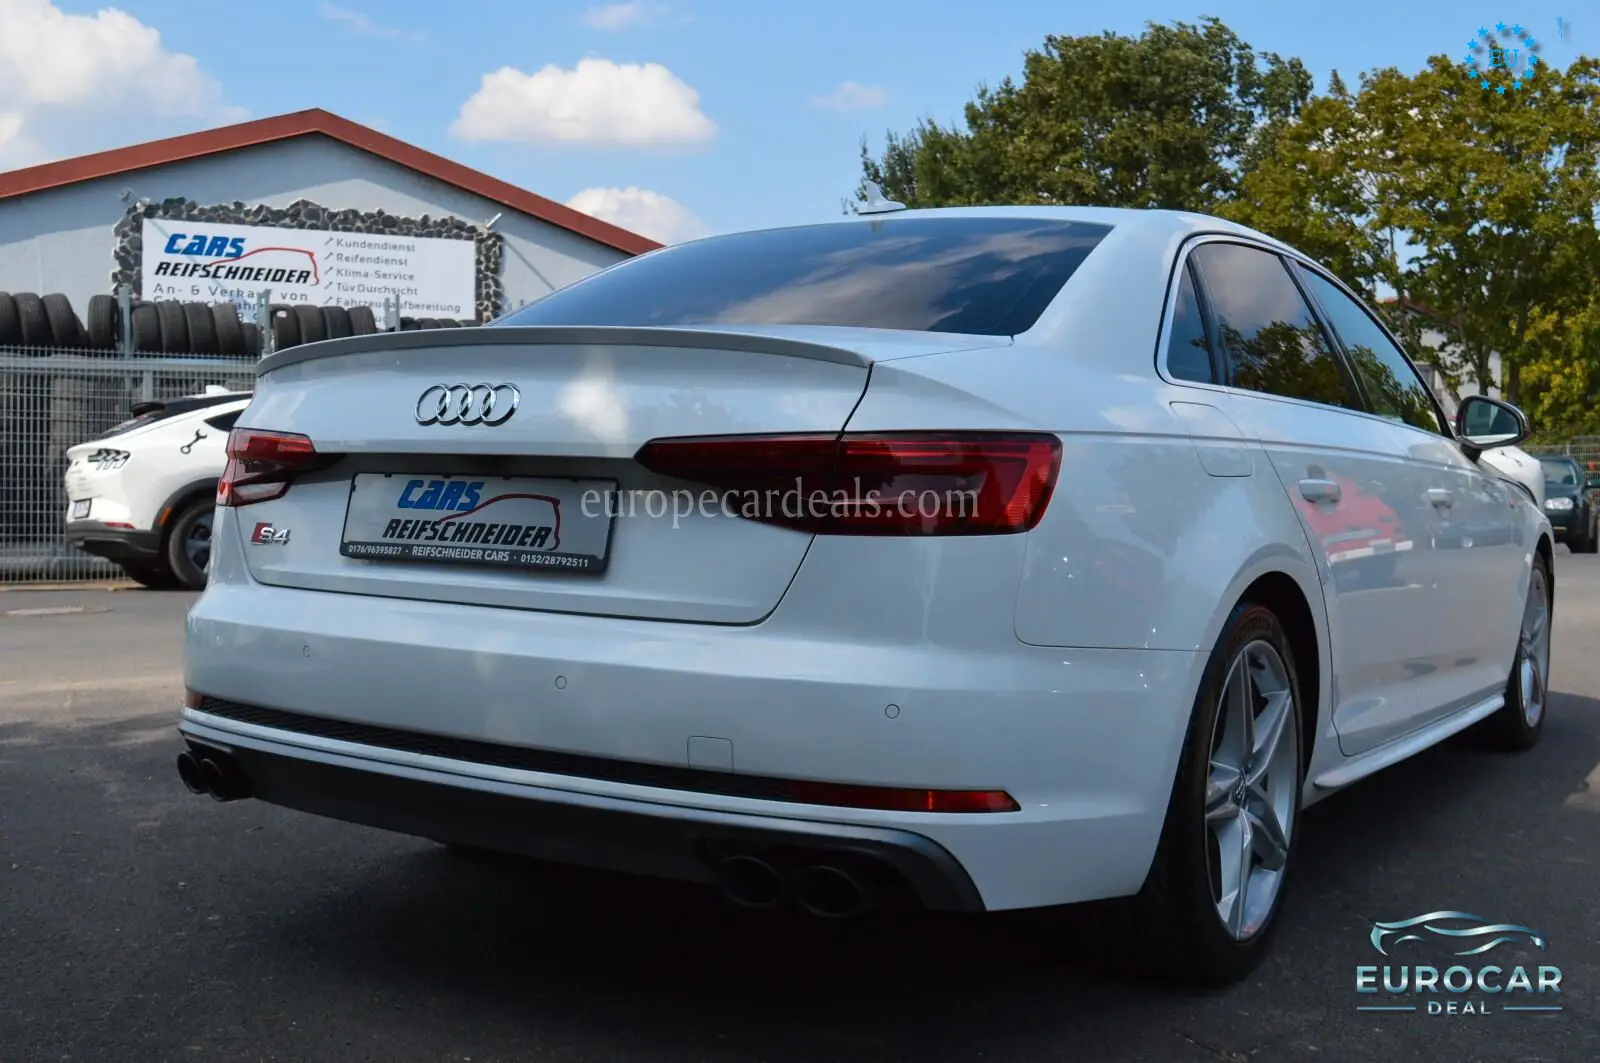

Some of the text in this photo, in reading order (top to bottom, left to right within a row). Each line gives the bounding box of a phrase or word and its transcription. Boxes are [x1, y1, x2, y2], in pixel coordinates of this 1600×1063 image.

[336, 238, 416, 253] Kundendienst
[336, 252, 408, 267] Reifendienst
[154, 261, 312, 285] REIFSCHNEIDER
[336, 268, 415, 281] Klima-Service
[280, 291, 308, 301] von
[382, 518, 552, 548] REIFSCHNEIDER
[412, 546, 482, 561] REIFSCHNEIDER
[484, 550, 510, 561] CARS
[520, 553, 589, 568] 0152/28792511
